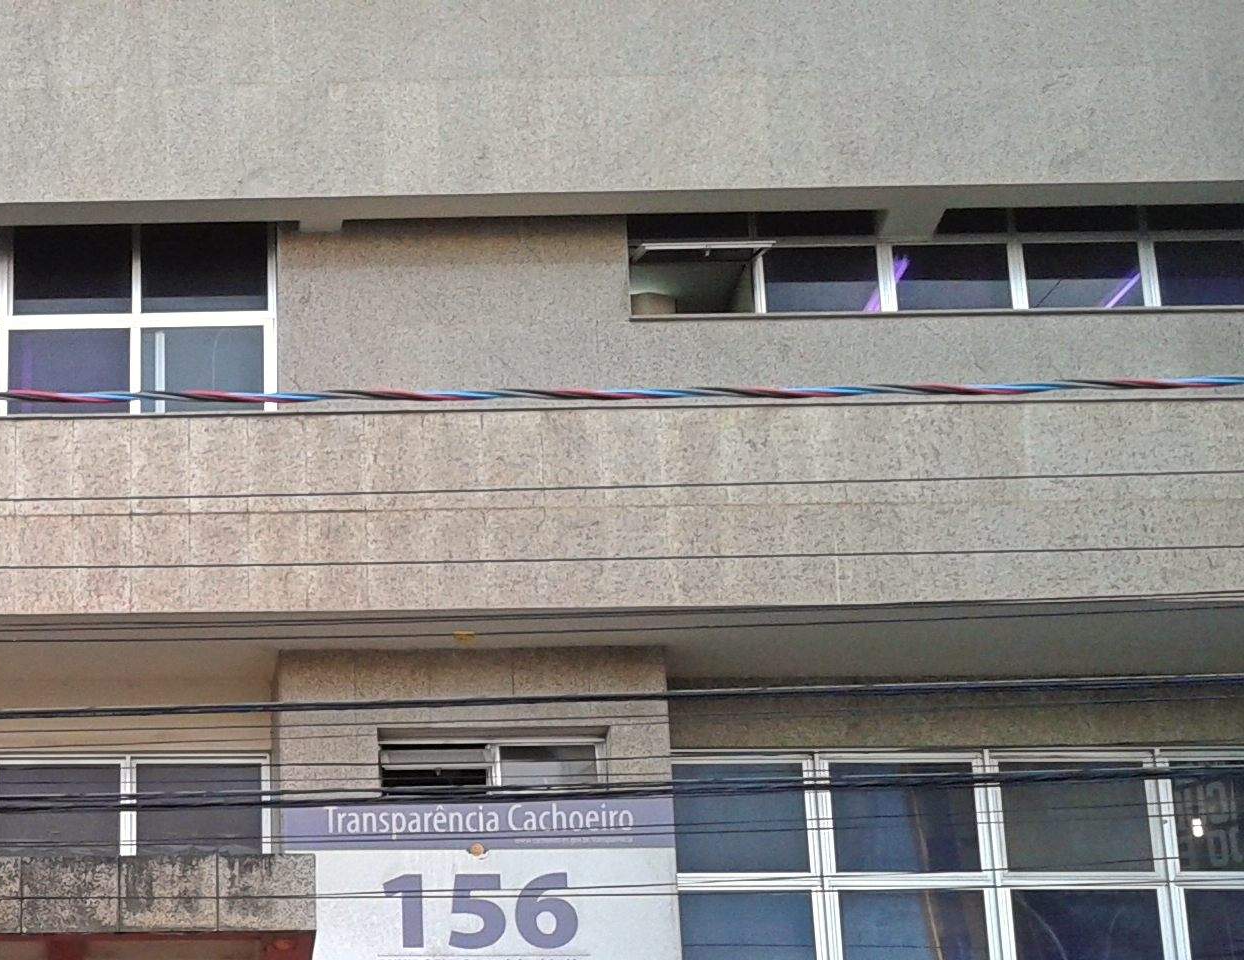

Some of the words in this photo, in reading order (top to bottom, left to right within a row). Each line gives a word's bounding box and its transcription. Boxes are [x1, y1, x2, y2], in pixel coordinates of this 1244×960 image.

[324, 804, 499, 840] Transparência
[508, 802, 634, 831] Cachoeiro
[382, 871, 579, 950] 156
